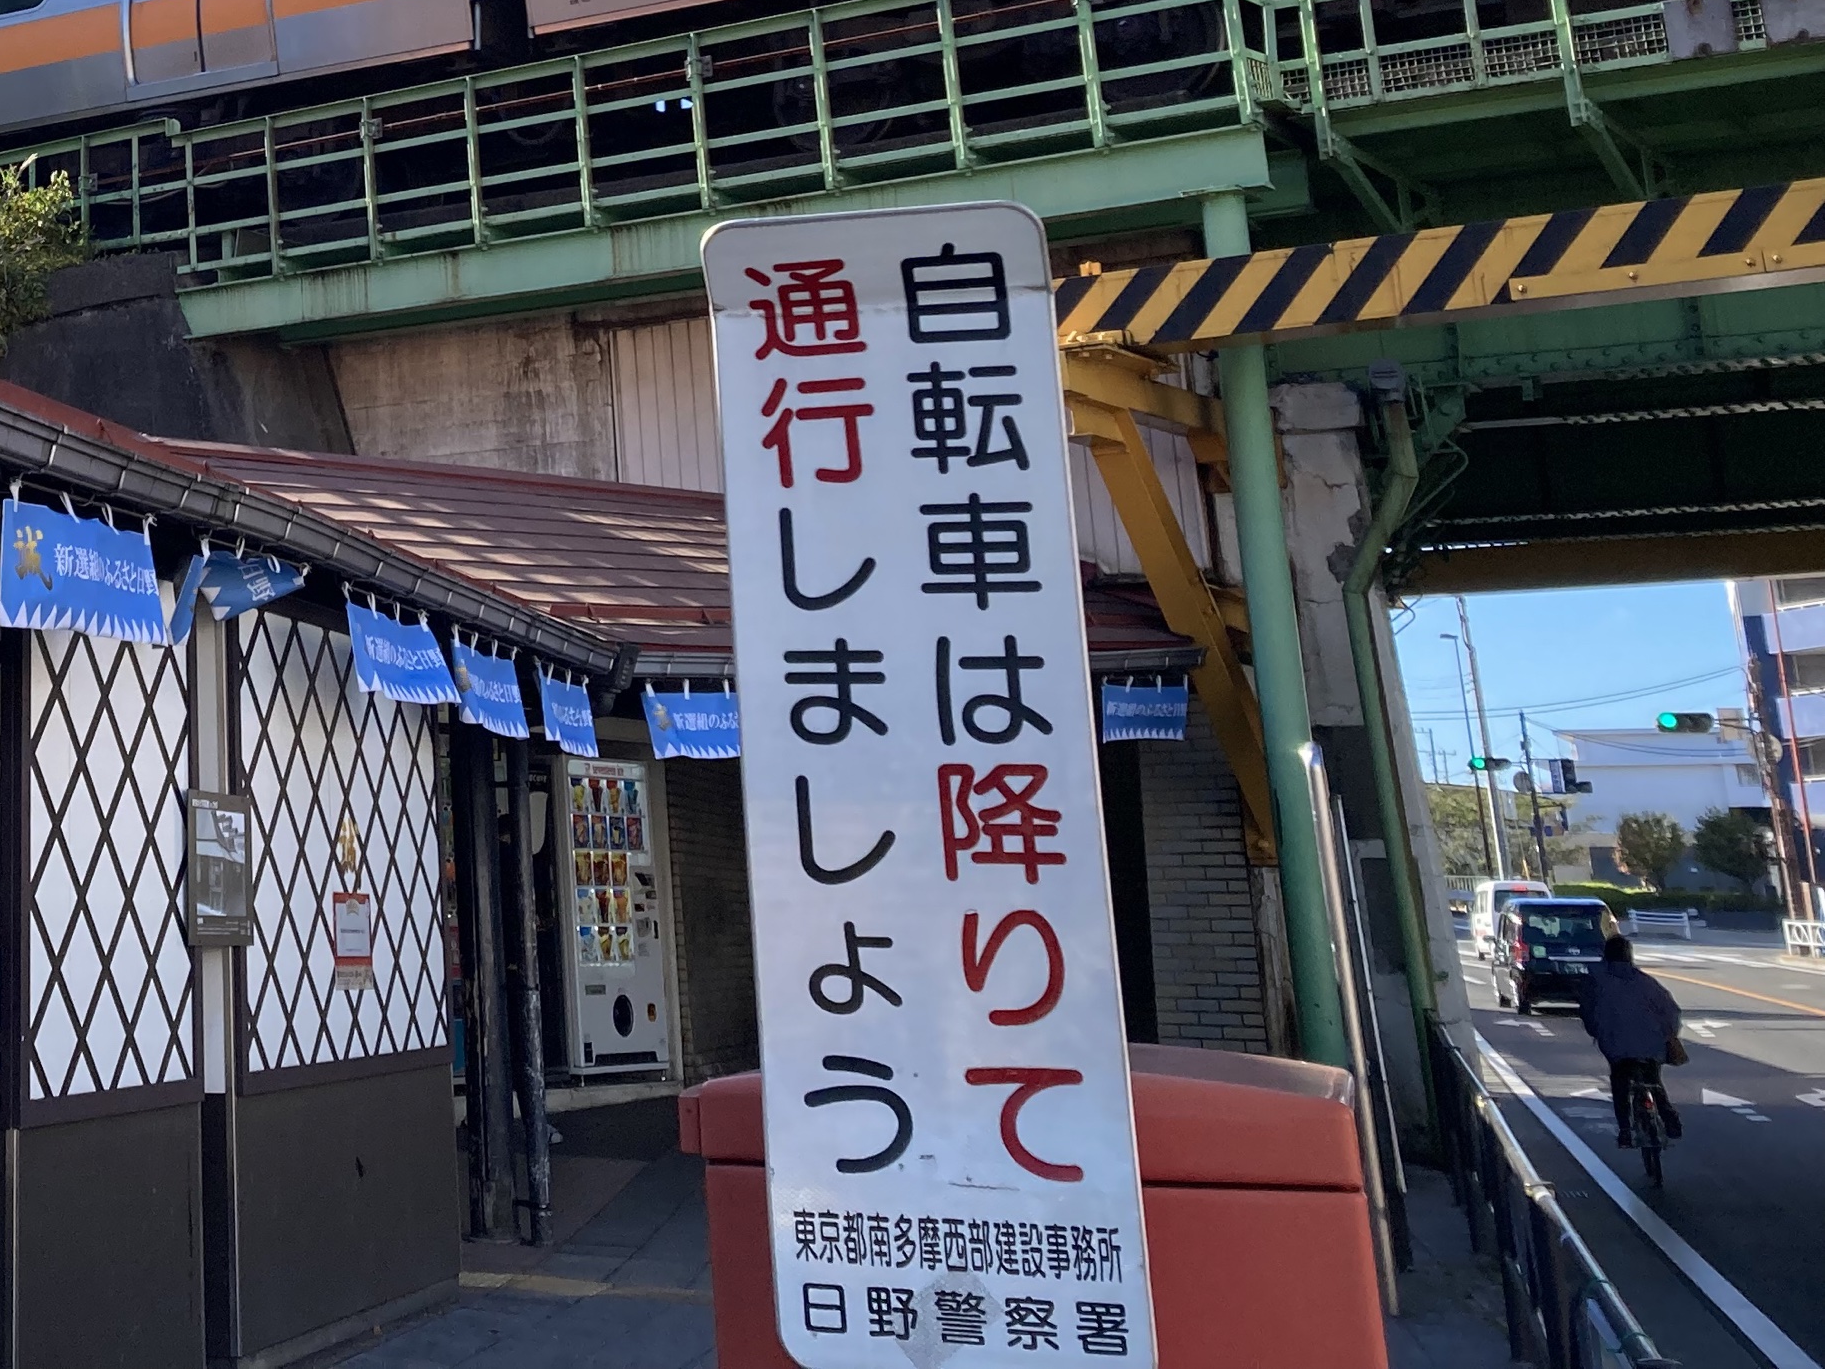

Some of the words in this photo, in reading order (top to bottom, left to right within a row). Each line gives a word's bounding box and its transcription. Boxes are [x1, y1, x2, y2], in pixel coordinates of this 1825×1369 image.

[744, 258, 914, 1174] 通行しましょう
[900, 242, 1085, 1183] 自転車は降りて
[793, 1207, 1124, 1284] 東京都南多摩西部建設事務所
[802, 1283, 1130, 1357] 日野警察署
